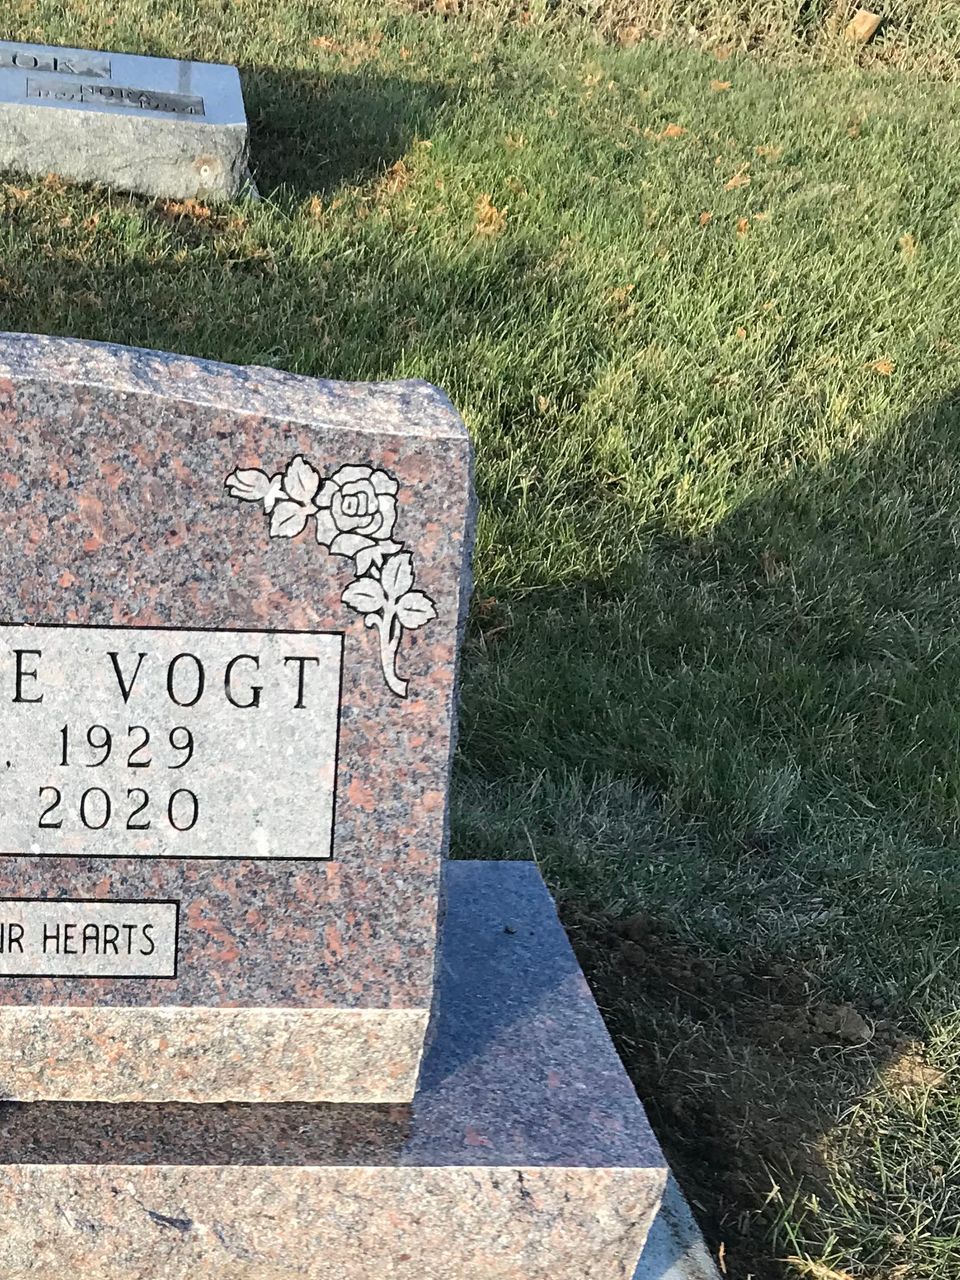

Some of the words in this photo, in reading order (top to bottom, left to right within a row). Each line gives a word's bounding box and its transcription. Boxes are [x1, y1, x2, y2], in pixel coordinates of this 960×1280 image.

[107, 652, 321, 709] VOGT
[59, 724, 195, 769] 1929
[38, 786, 200, 832] 2020
[43, 923, 156, 957] HEARTS
